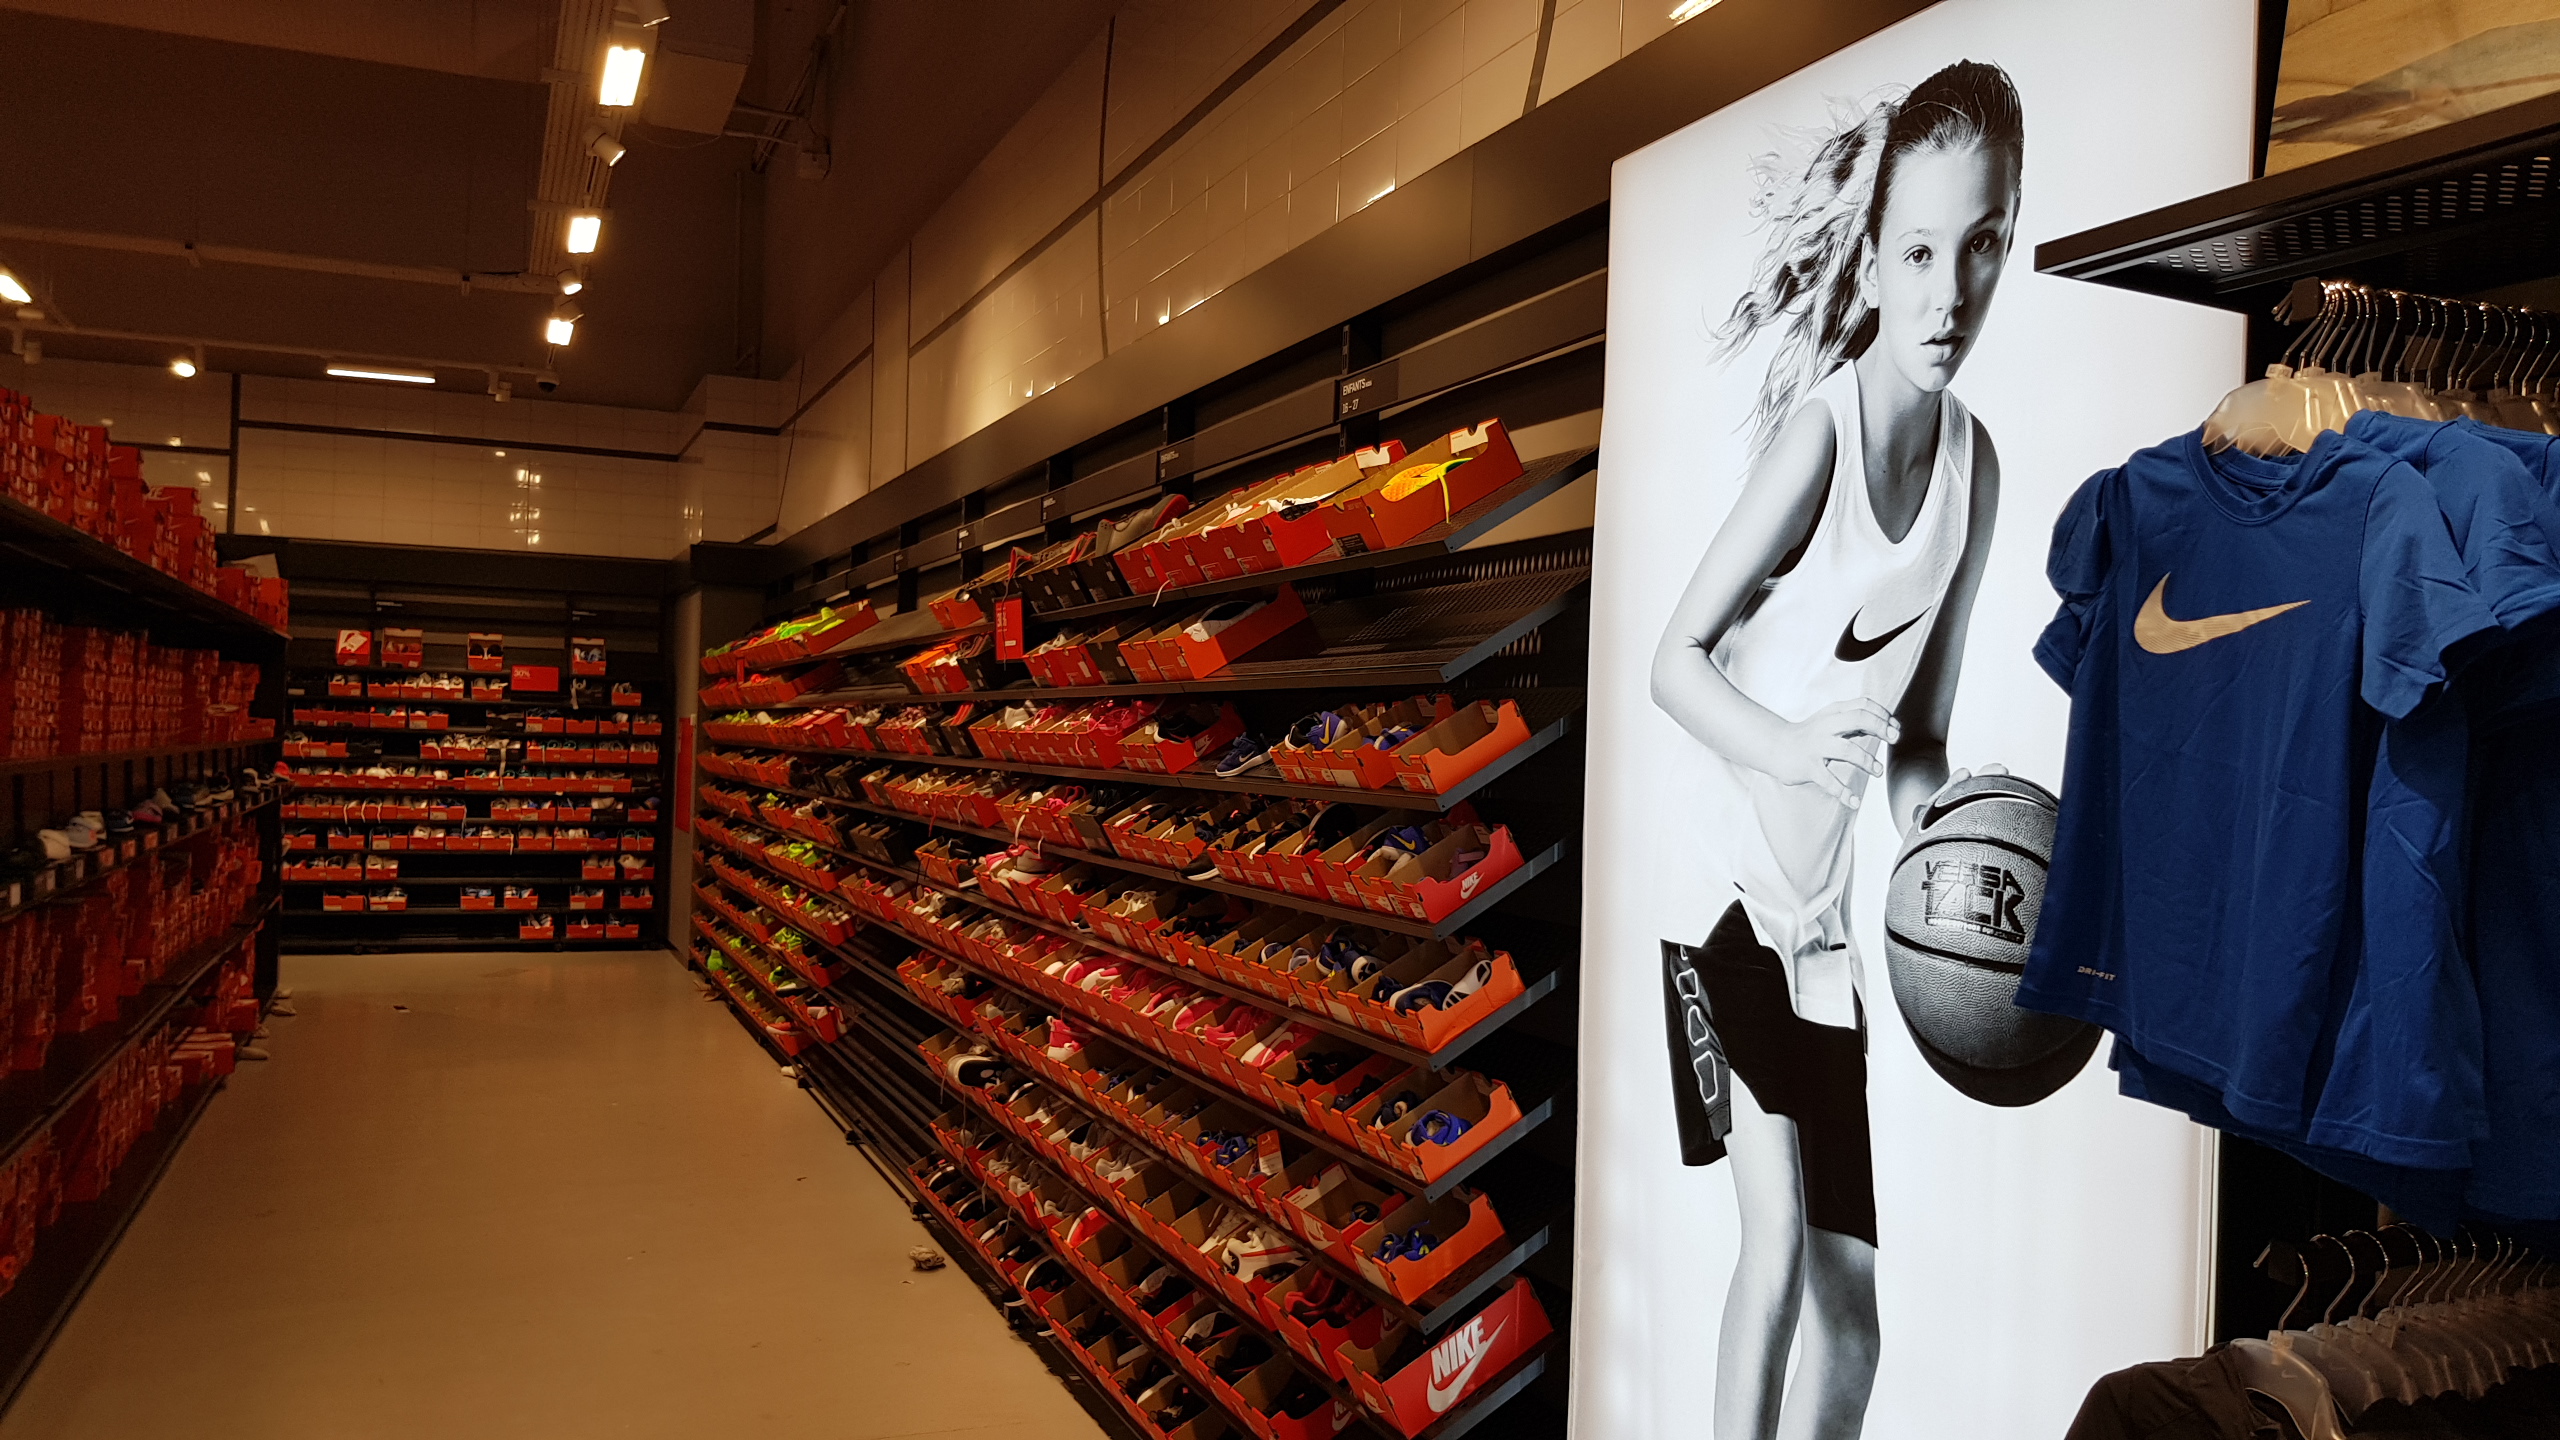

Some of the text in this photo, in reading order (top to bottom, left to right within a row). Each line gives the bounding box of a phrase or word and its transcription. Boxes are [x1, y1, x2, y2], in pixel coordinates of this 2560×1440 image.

[1342, 378, 1366, 396] ENFANTS
[1461, 872, 1480, 891] NIKE
[1925, 860, 2026, 897] VERSA
[1921, 880, 2026, 935] TACK
[2077, 966, 2117, 981] DRI-FIT
[1431, 1315, 1488, 1385] NIKE
